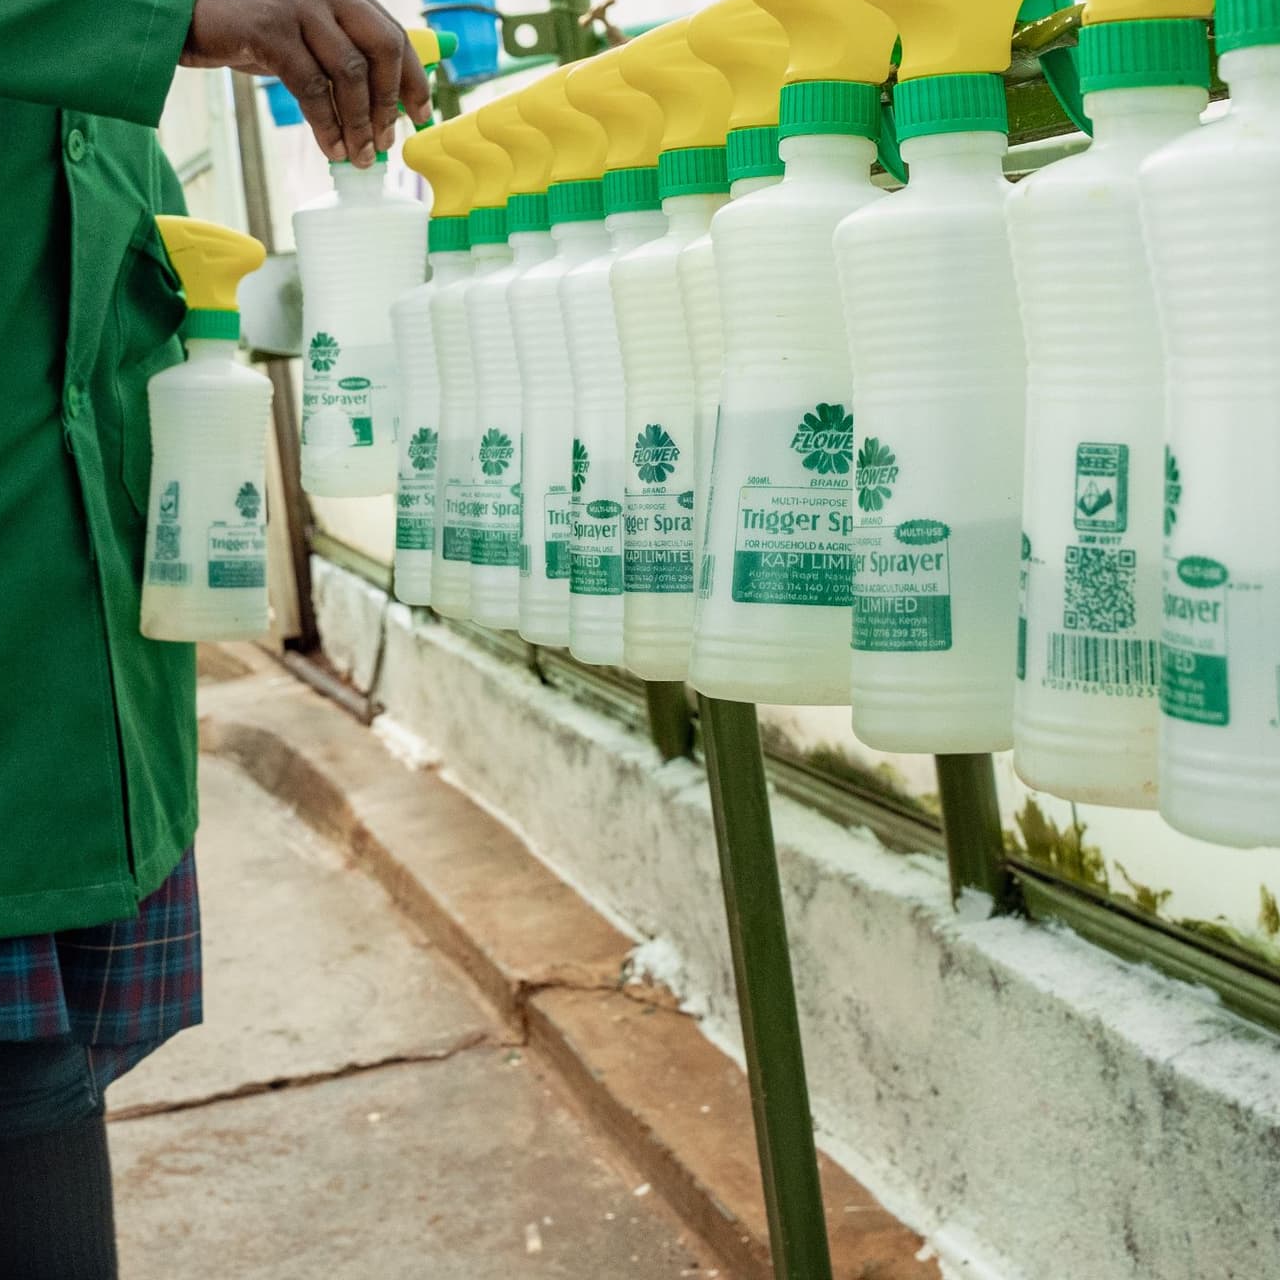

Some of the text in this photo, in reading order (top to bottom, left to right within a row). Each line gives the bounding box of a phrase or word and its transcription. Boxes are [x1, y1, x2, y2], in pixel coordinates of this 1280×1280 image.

[320, 391, 368, 407] Sprayer
[790, 432, 853, 451] FLOWE
[478, 446, 514, 460] FLOWER
[632, 448, 681, 464] FLOWER
[748, 476, 771, 485] 500ML
[810, 479, 849, 488] BRAND
[642, 486, 667, 495] BRAND
[771, 497, 848, 507] MULTI-PURPOSE
[742, 508, 821, 535] Trigger
[573, 521, 619, 540] Sprayer
[899, 527, 943, 537] MULTI-USE
[744, 540, 760, 549] FOR
[761, 541, 817, 551] HOUSEHOLD
[645, 551, 694, 564] LIMITE
[761, 553, 804, 568] KAPI
[869, 551, 943, 576] Sprayer
[758, 582, 784, 591] 0726
[786, 582, 801, 591] 114
[804, 583, 823, 592] 140
[832, 585, 853, 594] 071
[921, 582, 938, 593] USE
[861, 596, 918, 613] LIMITED
[892, 627, 909, 637] 299
[910, 627, 928, 637] 375
